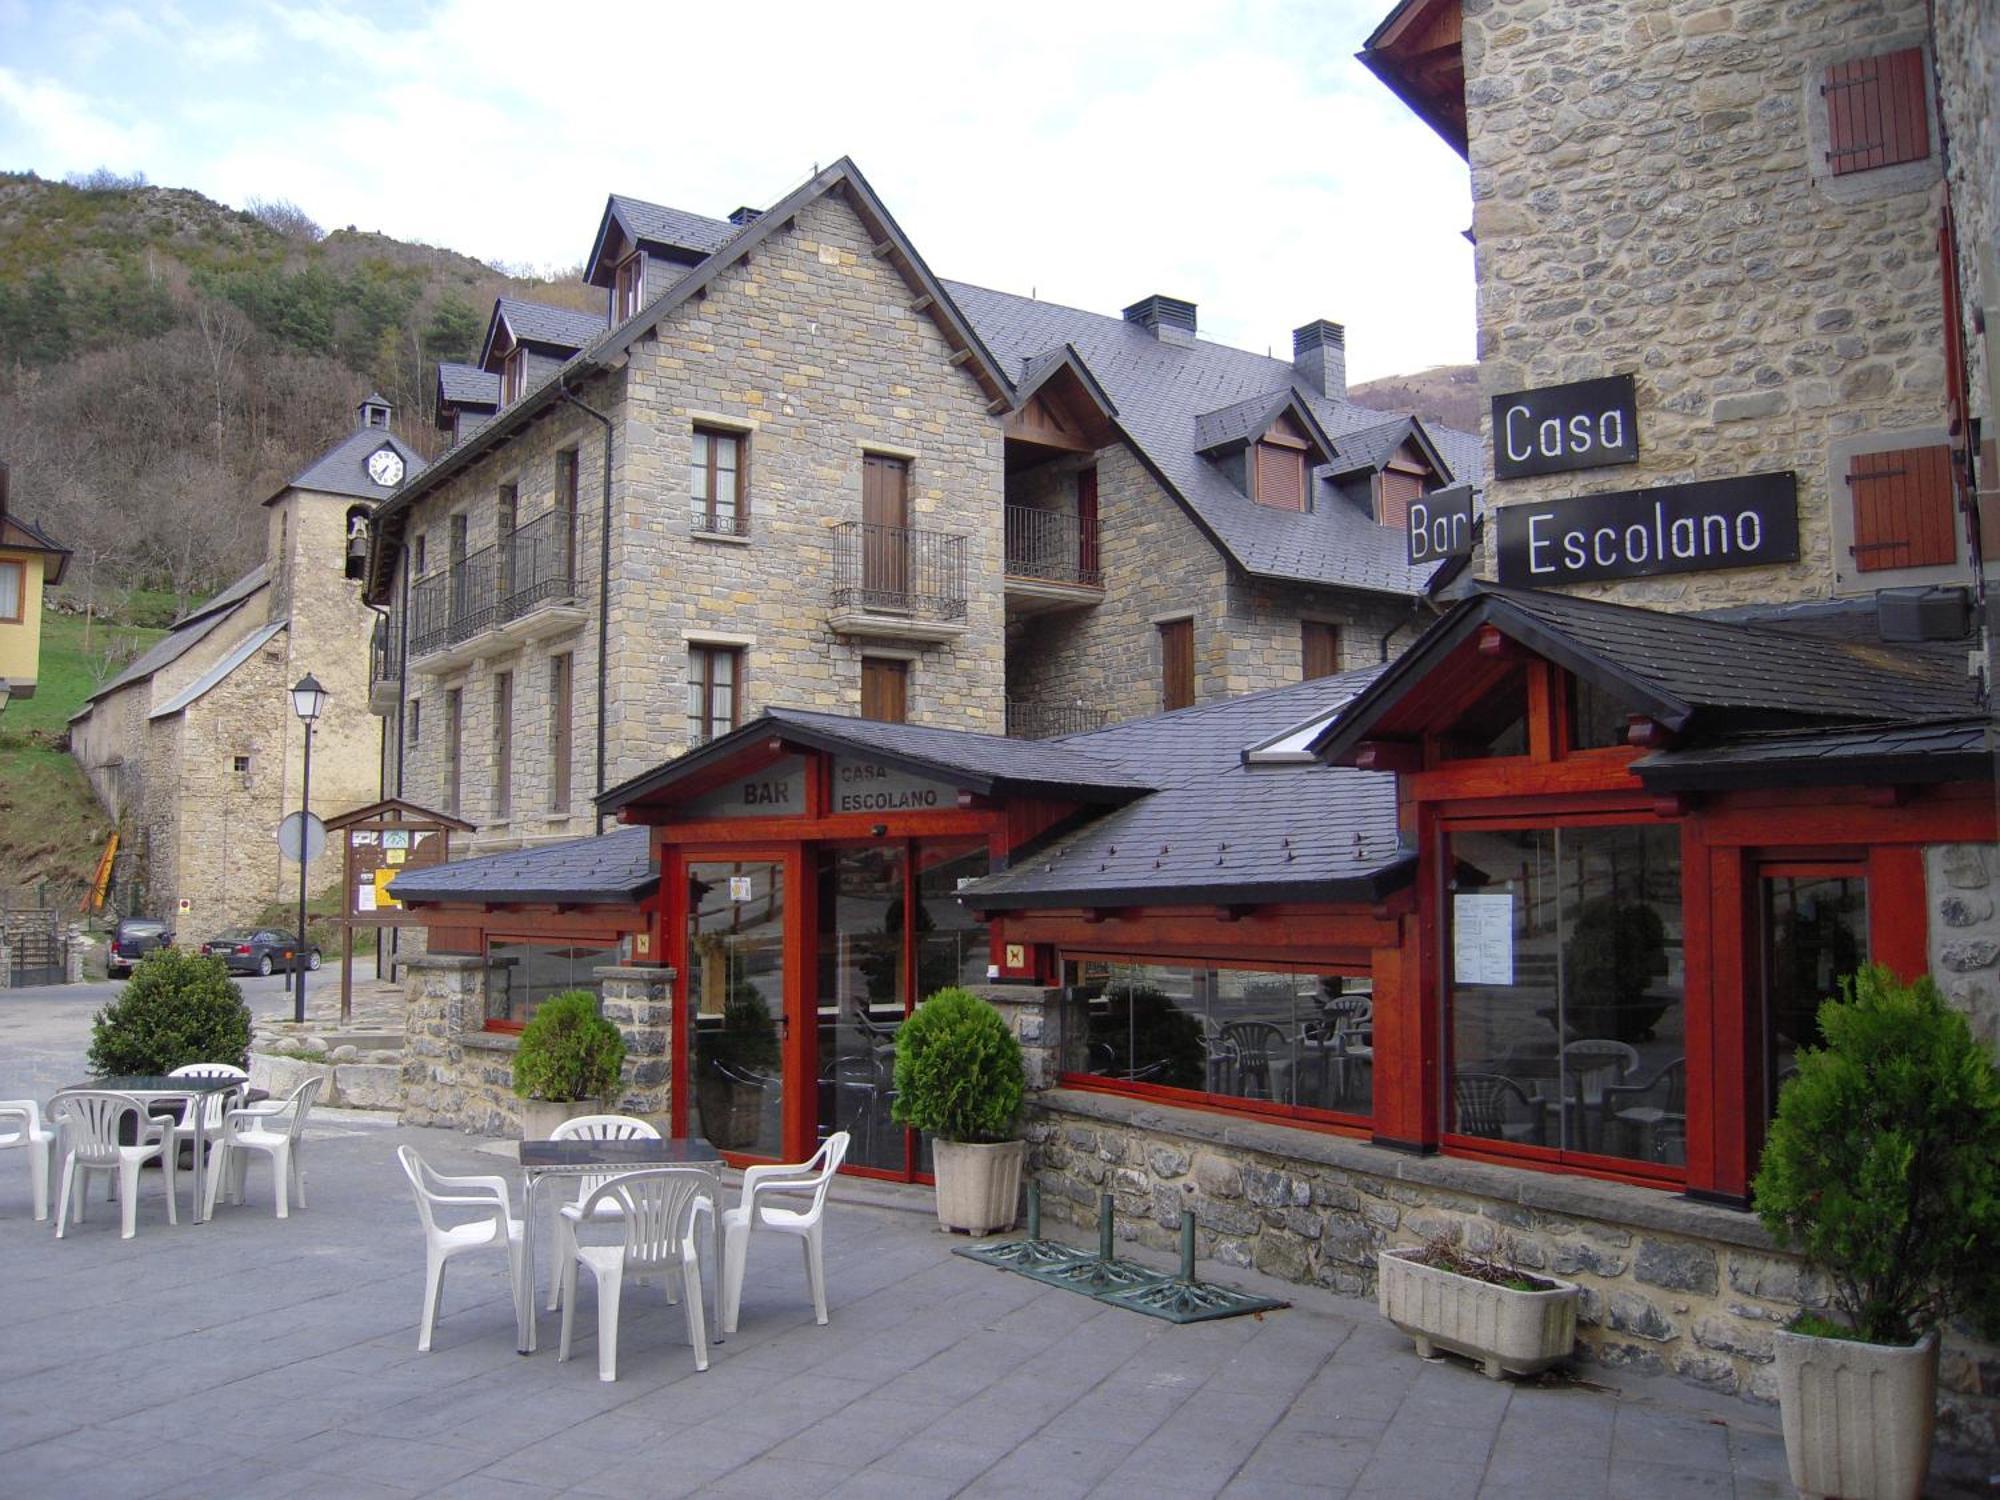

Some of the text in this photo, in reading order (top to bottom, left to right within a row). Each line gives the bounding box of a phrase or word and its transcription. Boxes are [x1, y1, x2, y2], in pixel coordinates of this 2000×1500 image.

[1506, 405, 1621, 462] Casa
[1411, 504, 1467, 558] Bar
[1528, 501, 1761, 574] Escolano
[743, 781, 789, 804] BAR
[841, 766, 887, 782] CASA
[841, 789, 937, 811] ESCOLANO
